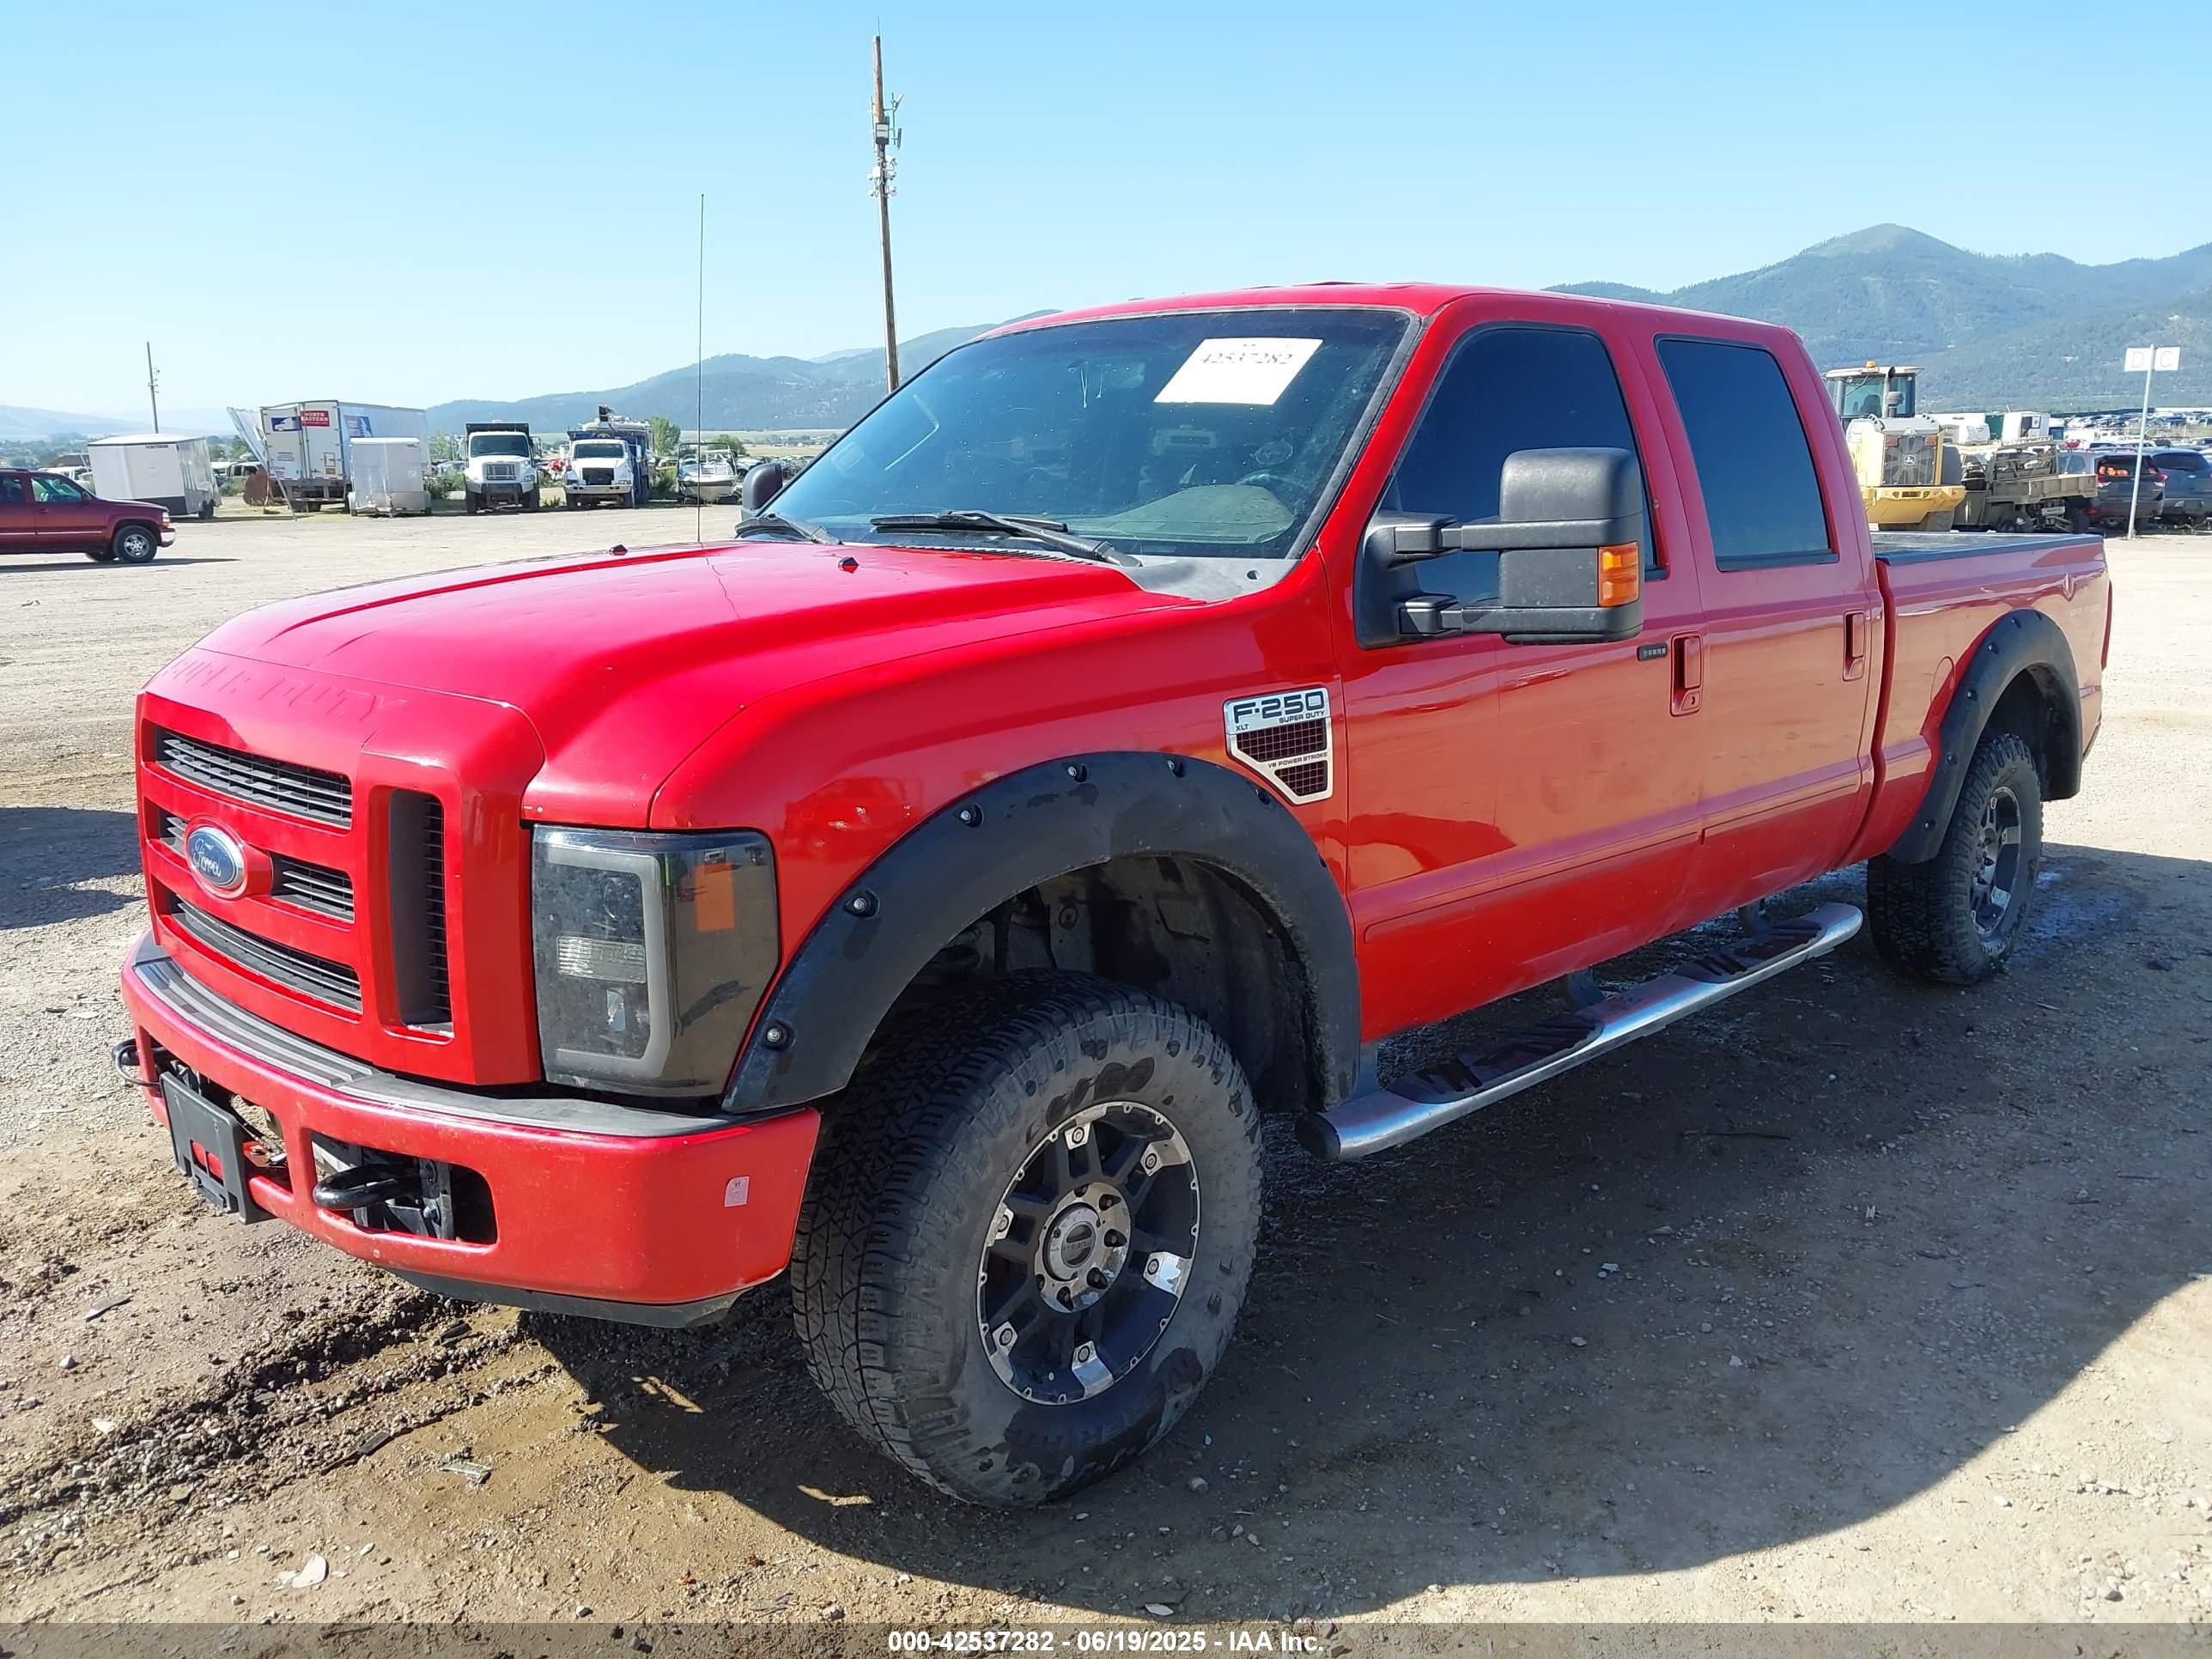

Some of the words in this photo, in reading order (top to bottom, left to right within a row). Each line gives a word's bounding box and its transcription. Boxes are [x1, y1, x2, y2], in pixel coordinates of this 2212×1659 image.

[2131, 350, 2144, 368] D
[2160, 350, 2172, 368] C
[1233, 690, 1325, 724] F-250
[1279, 714, 1304, 724] SUPER
[1305, 710, 1326, 720] DUTY
[1236, 723, 1249, 732] XLT
[1278, 757, 1303, 767] POWER
[1303, 751, 1328, 762] STROKE
[193, 838, 222, 877] Ford
